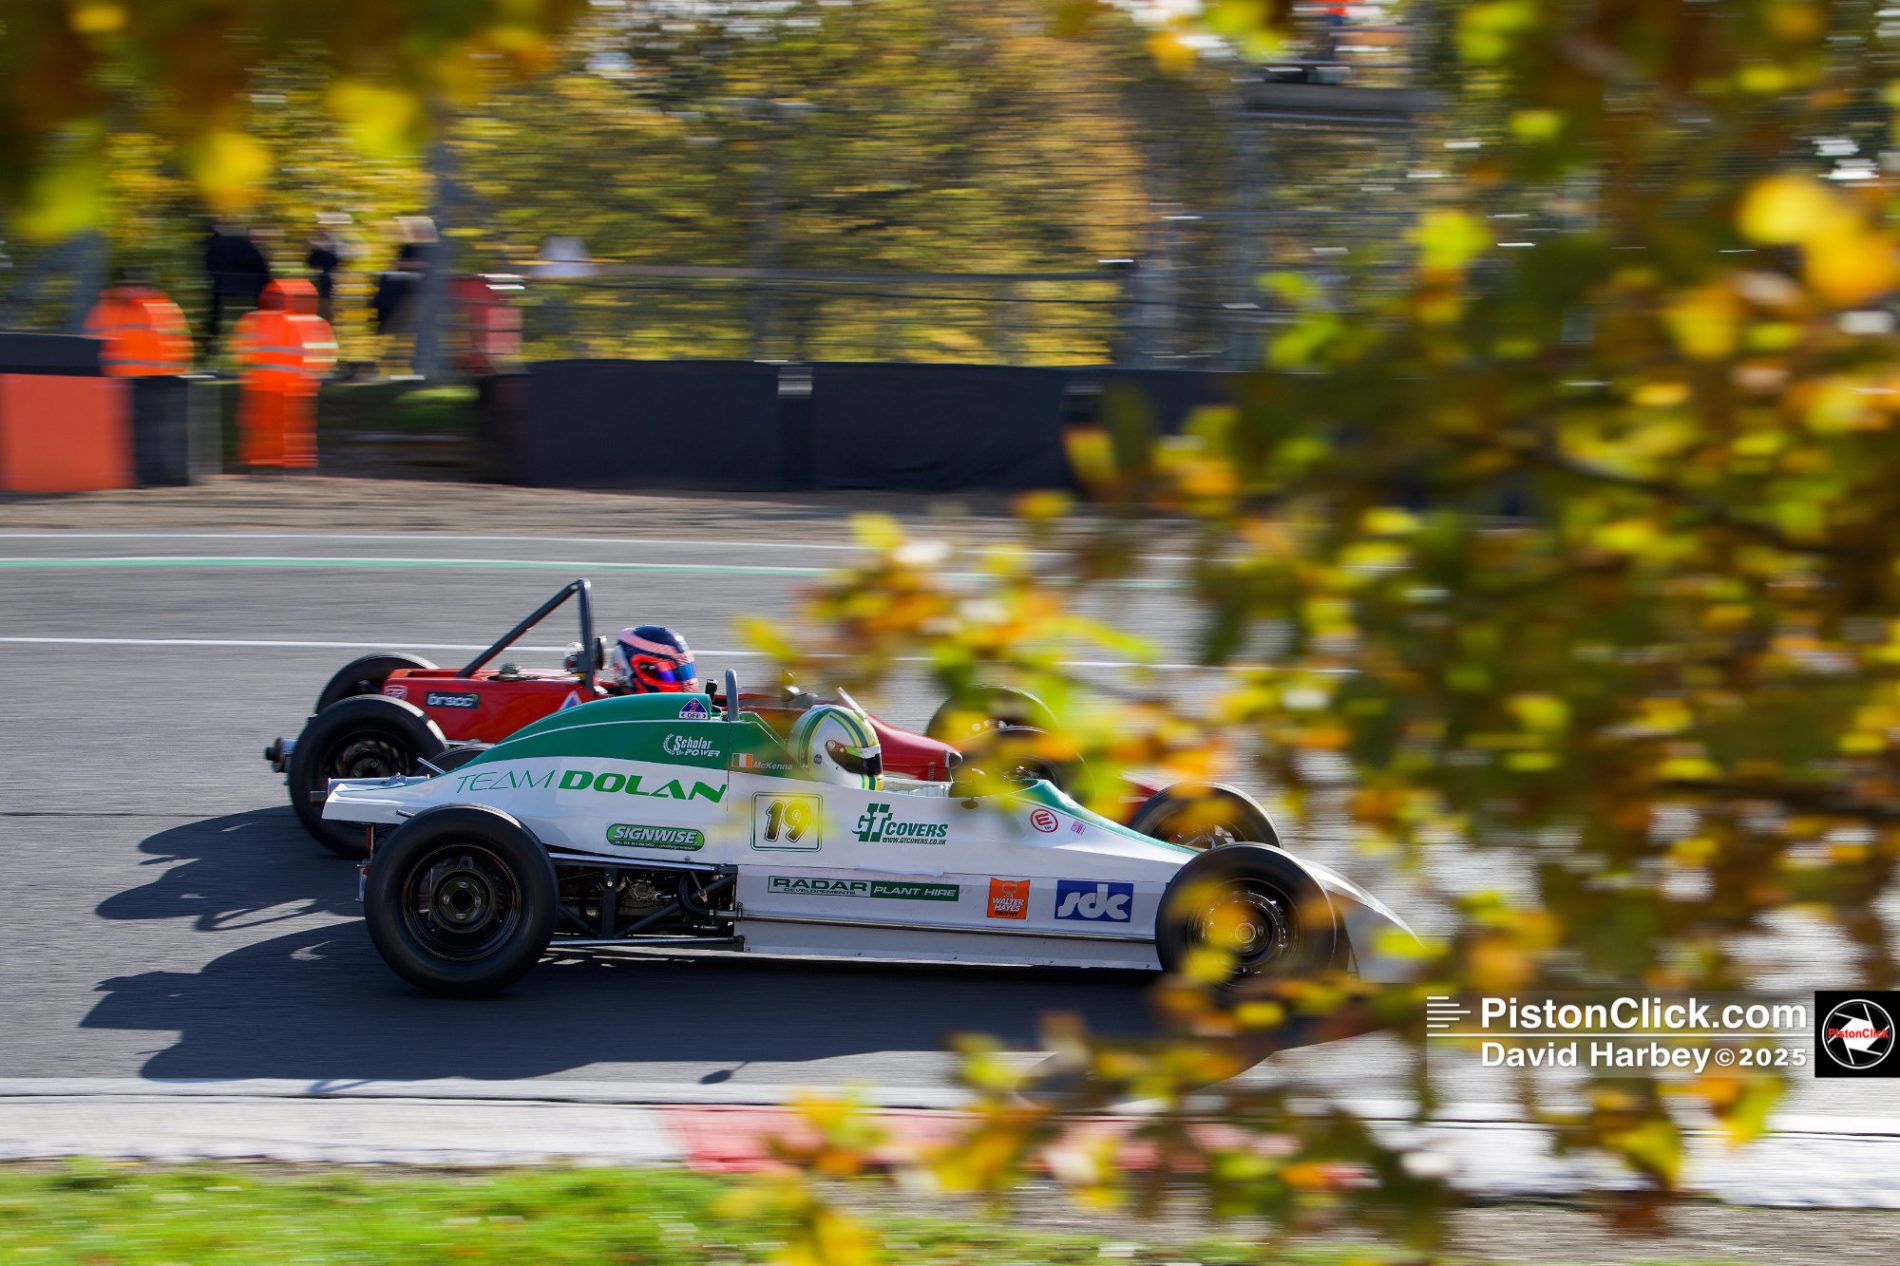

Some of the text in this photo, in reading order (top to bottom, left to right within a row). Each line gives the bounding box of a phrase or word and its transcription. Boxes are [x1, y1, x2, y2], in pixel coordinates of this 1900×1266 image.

[426, 693, 474, 707] brscc
[674, 735, 713, 752] Scholar
[685, 749, 721, 758] POWER
[753, 760, 793, 771] McKenna
[456, 769, 728, 804] TEAM DOLAN
[764, 800, 812, 844] 19
[885, 822, 949, 838] COVERS
[614, 826, 697, 844] SIGNWISE
[773, 878, 957, 898] RADAR PLANT HIRE
[992, 897, 1024, 907] WALTER
[994, 904, 1021, 912] HAYES
[1057, 883, 1131, 920] sdc
